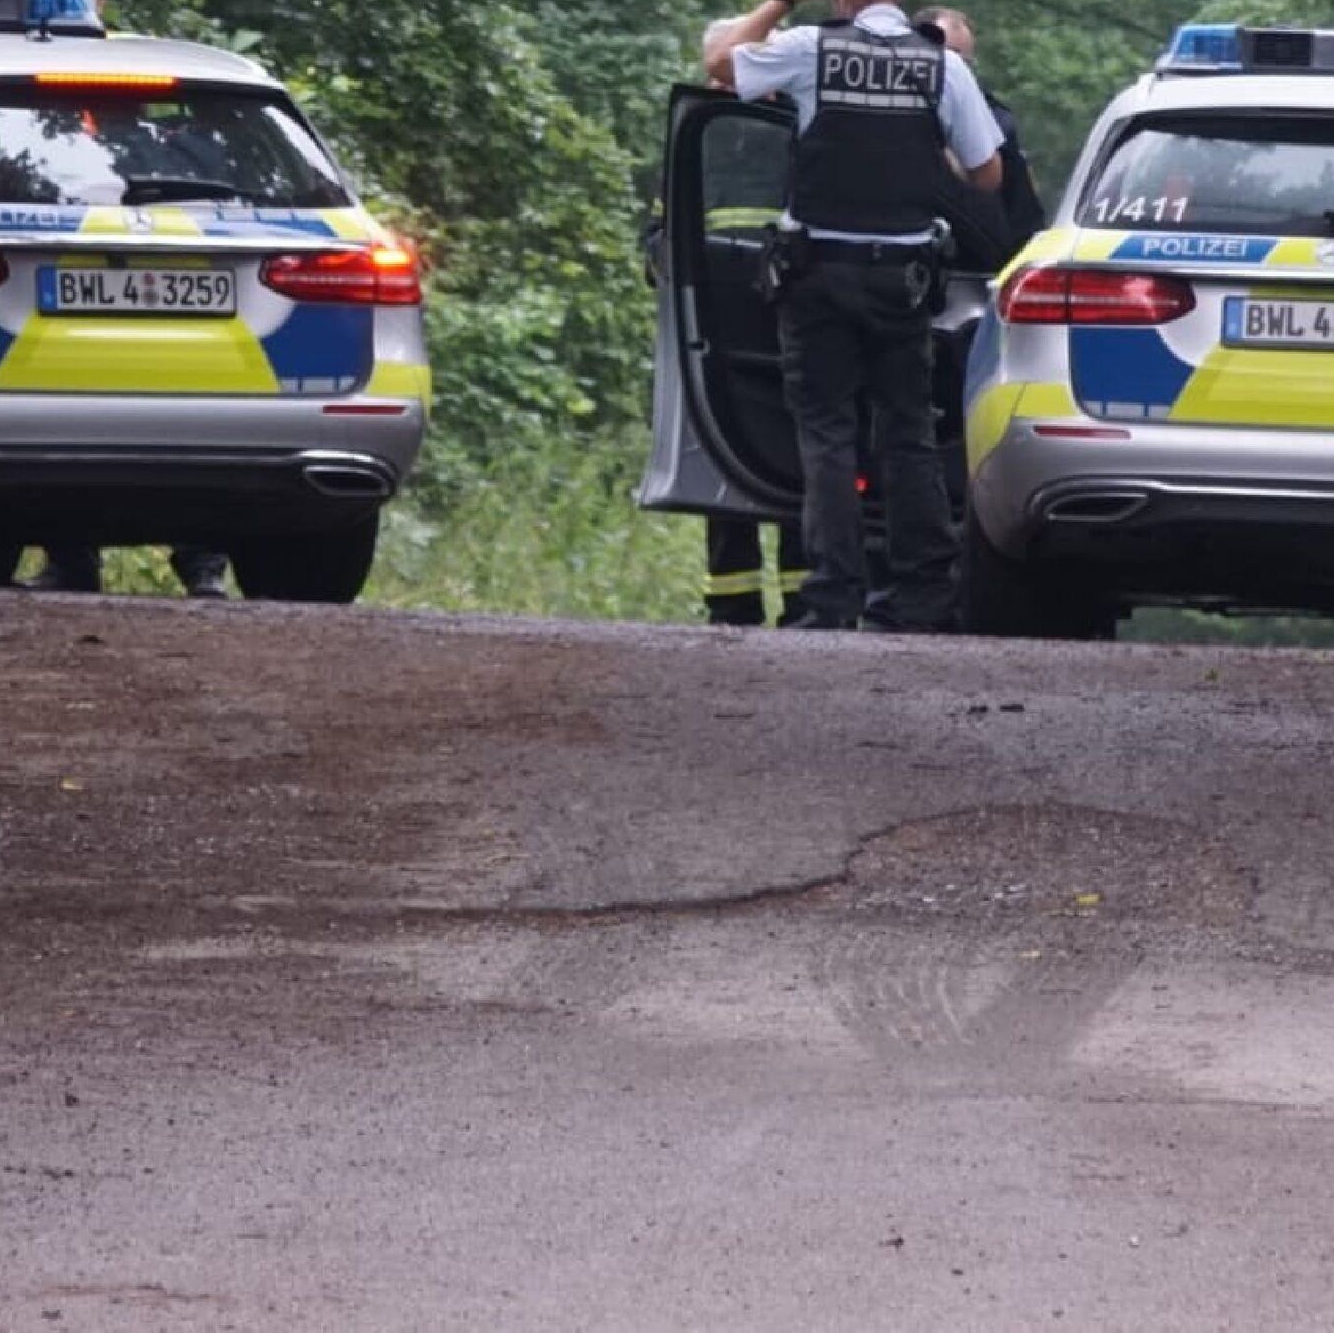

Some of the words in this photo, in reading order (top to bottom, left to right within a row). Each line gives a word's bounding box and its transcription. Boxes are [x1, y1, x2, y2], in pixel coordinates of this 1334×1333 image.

[823, 53, 937, 92] POLIZEI
[1094, 196, 1189, 224] 1/411
[1141, 237, 1248, 258] POLIZEI
[59, 272, 116, 305] BWL
[122, 274, 139, 305] 4
[160, 274, 231, 307] 3259
[1246, 303, 1305, 337] BWL
[1313, 306, 1331, 339] 4
